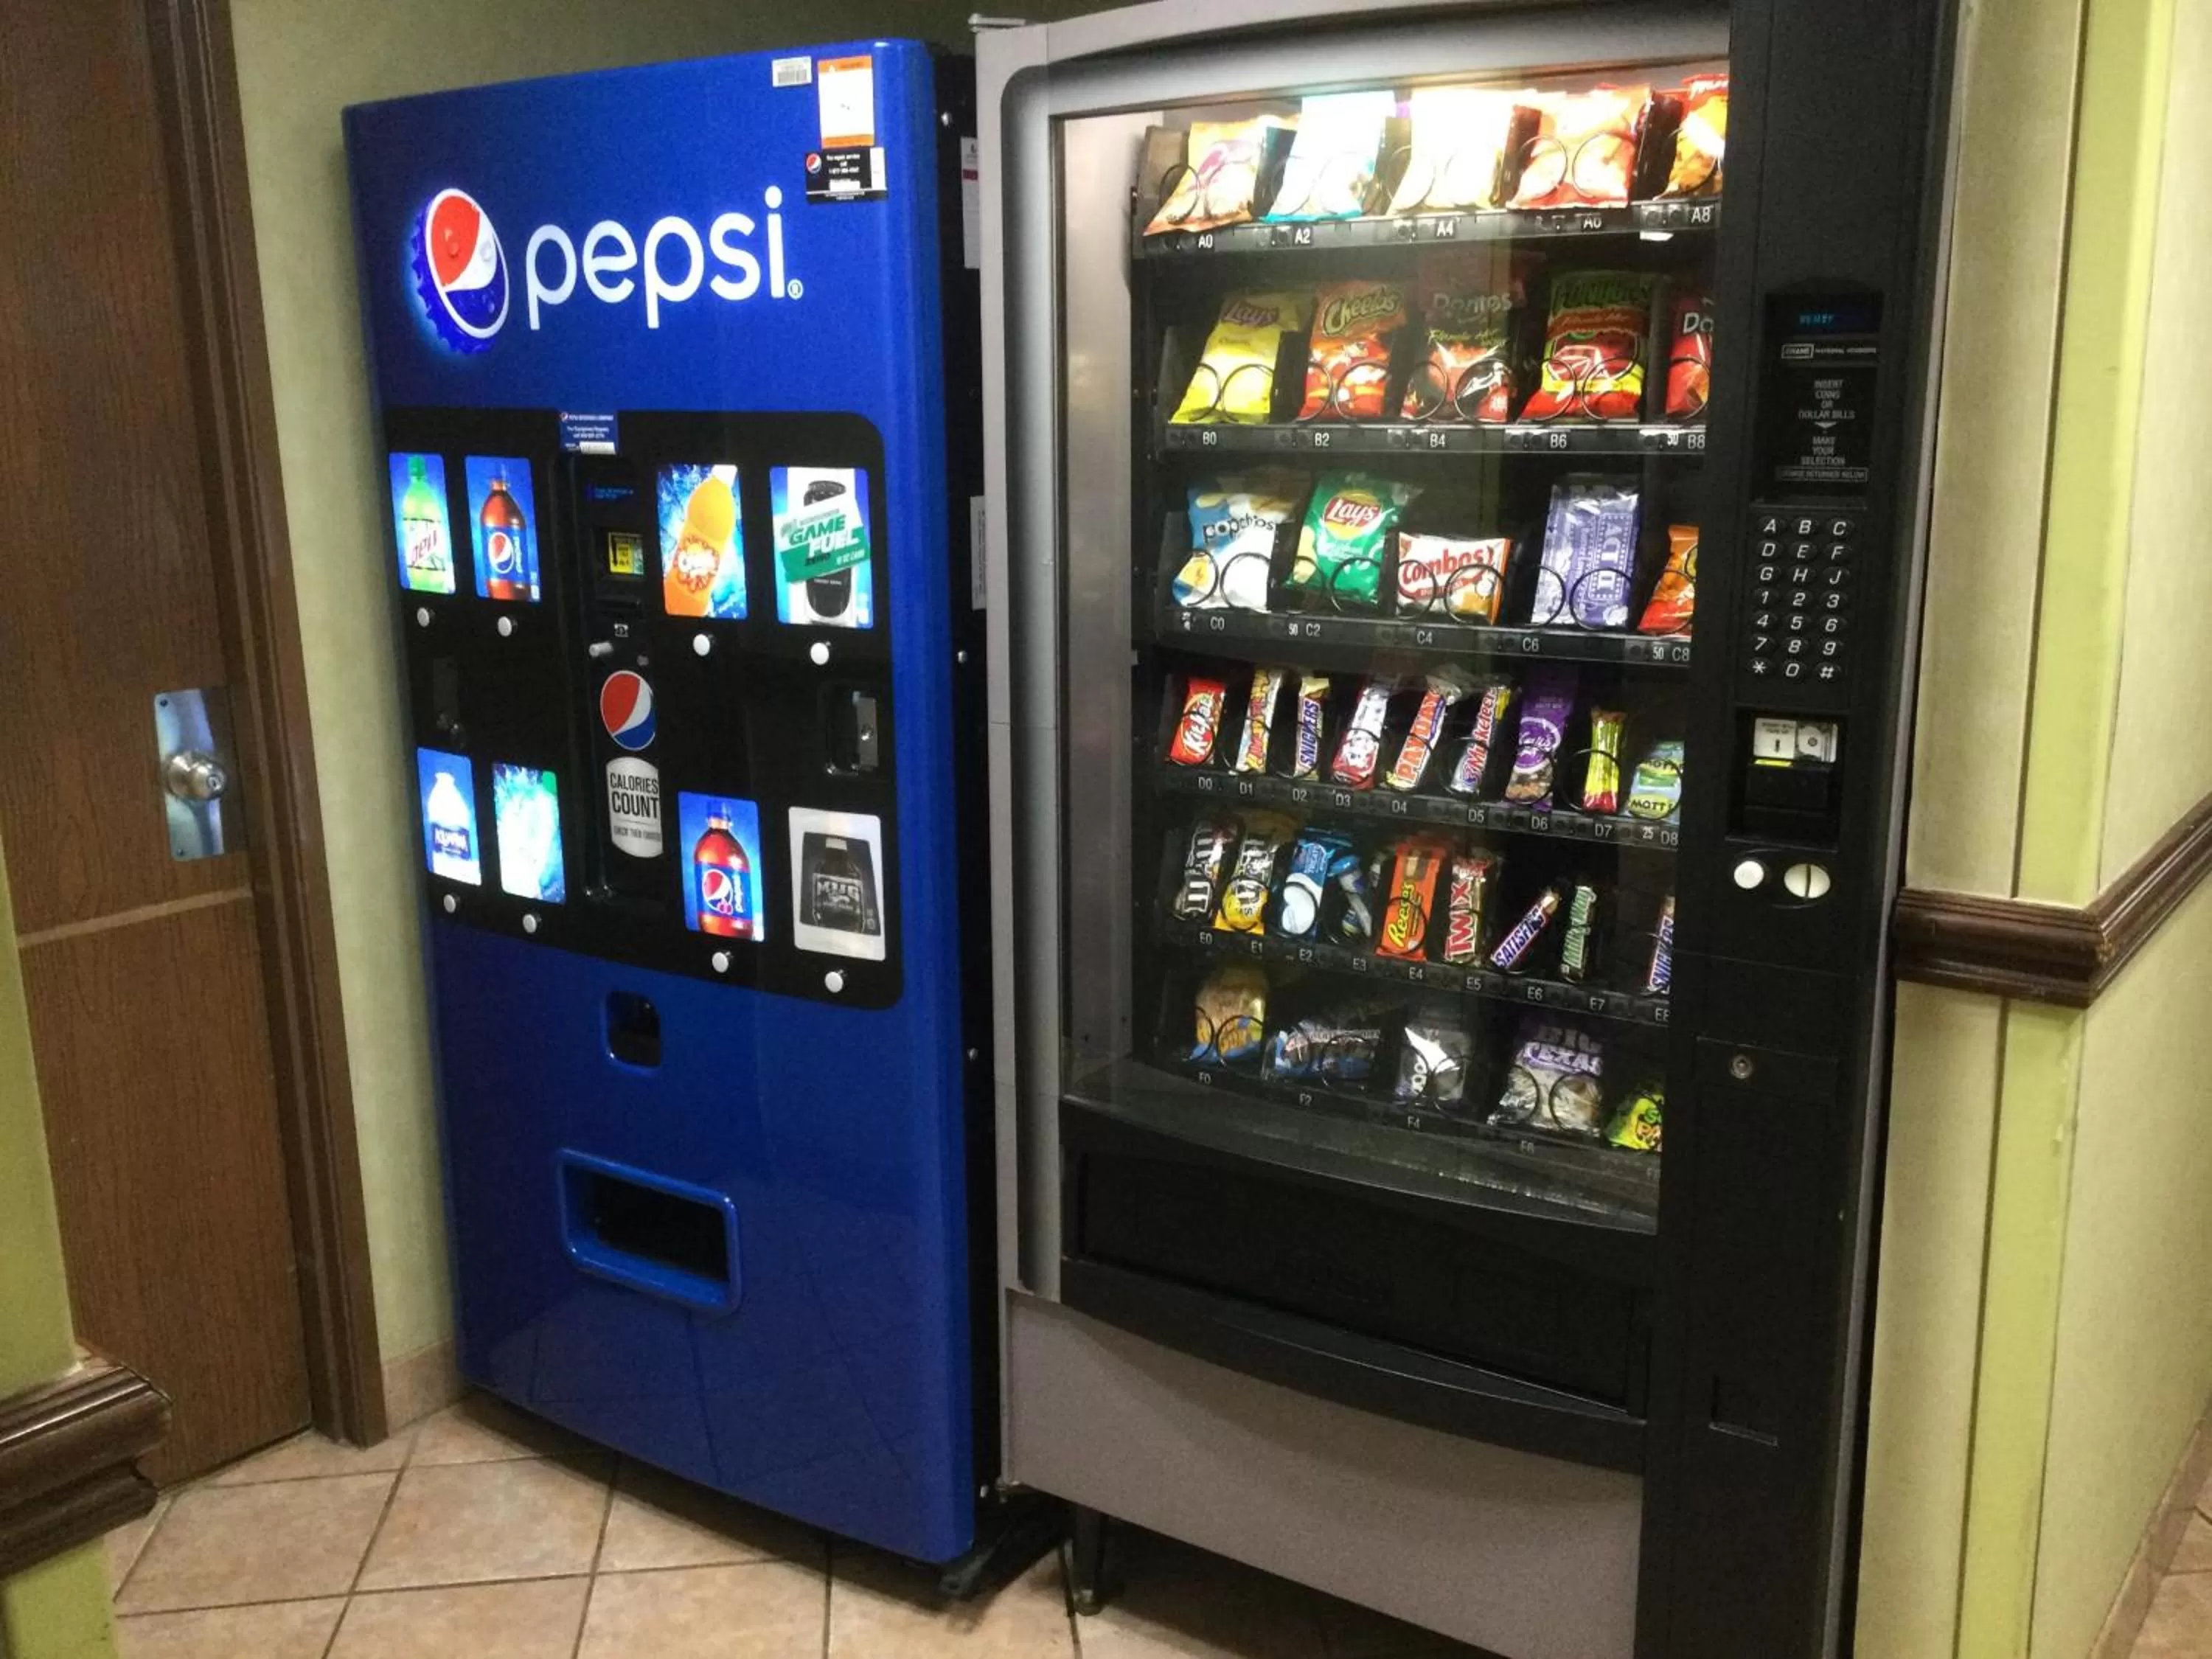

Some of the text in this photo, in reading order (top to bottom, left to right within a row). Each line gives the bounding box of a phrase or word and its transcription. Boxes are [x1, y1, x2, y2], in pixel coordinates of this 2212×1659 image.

[1691, 207, 1711, 223] A8
[1295, 228, 1310, 244] A2
[1436, 222, 1453, 236] A4
[1198, 234, 1213, 248] A0
[525, 186, 785, 330] pepsi
[1325, 292, 1397, 334] Cheetos
[1203, 432, 1217, 445] B0
[1315, 433, 1329, 446] B2
[1430, 433, 1445, 448] B4
[1551, 434, 1567, 448] B6
[1688, 435, 1705, 449] B8
[790, 514, 846, 545] GAME
[1763, 518, 1776, 533] A
[1798, 519, 1812, 535] B
[1833, 521, 1846, 535] C
[808, 530, 860, 557] FUEL
[1761, 543, 1775, 557] D
[1797, 544, 1809, 558] E
[1831, 546, 1843, 560] F
[1402, 548, 1484, 585] Combos
[1760, 566, 1773, 580] G
[1792, 568, 1808, 582] H
[1829, 569, 1842, 585] J
[1761, 591, 1769, 605] 1
[1792, 592, 1806, 607] 2
[1826, 594, 1840, 608] 3
[1211, 616, 1225, 630] C0
[1757, 614, 1769, 627] 4
[1790, 616, 1803, 630] 5
[1825, 618, 1838, 632] 6
[1307, 623, 1321, 636] C2
[1416, 631, 1433, 644] C4
[1755, 636, 1767, 651] 7
[1523, 638, 1539, 653] C6
[1788, 639, 1801, 653] 8
[1823, 641, 1836, 655] 9
[1652, 647, 1689, 662] 50 C8
[1300, 700, 1320, 767] SNICKERS
[610, 772, 658, 794] CALORIES
[1198, 777, 1213, 790] D0
[1239, 782, 1253, 795] D1
[1293, 789, 1307, 802] D2
[1335, 794, 1351, 807] D3
[612, 790, 658, 819] COUNT
[1392, 801, 1407, 813] D4
[1468, 810, 1484, 824] D5
[1531, 816, 1548, 831] D6
[1595, 824, 1612, 838] D7
[1643, 826, 1678, 846] 25 D8
[817, 881, 860, 902] MUG
[1450, 880, 1474, 956] TWIX
[1200, 931, 1213, 945] E0
[1495, 908, 1545, 967] SATISFIS
[1251, 941, 1263, 953] E1
[1299, 949, 1312, 961] E2
[1353, 959, 1366, 971] E3
[1409, 967, 1423, 979] E4
[1467, 977, 1481, 991] E5
[1527, 986, 1543, 1001] E6
[1590, 997, 1605, 1010] E7
